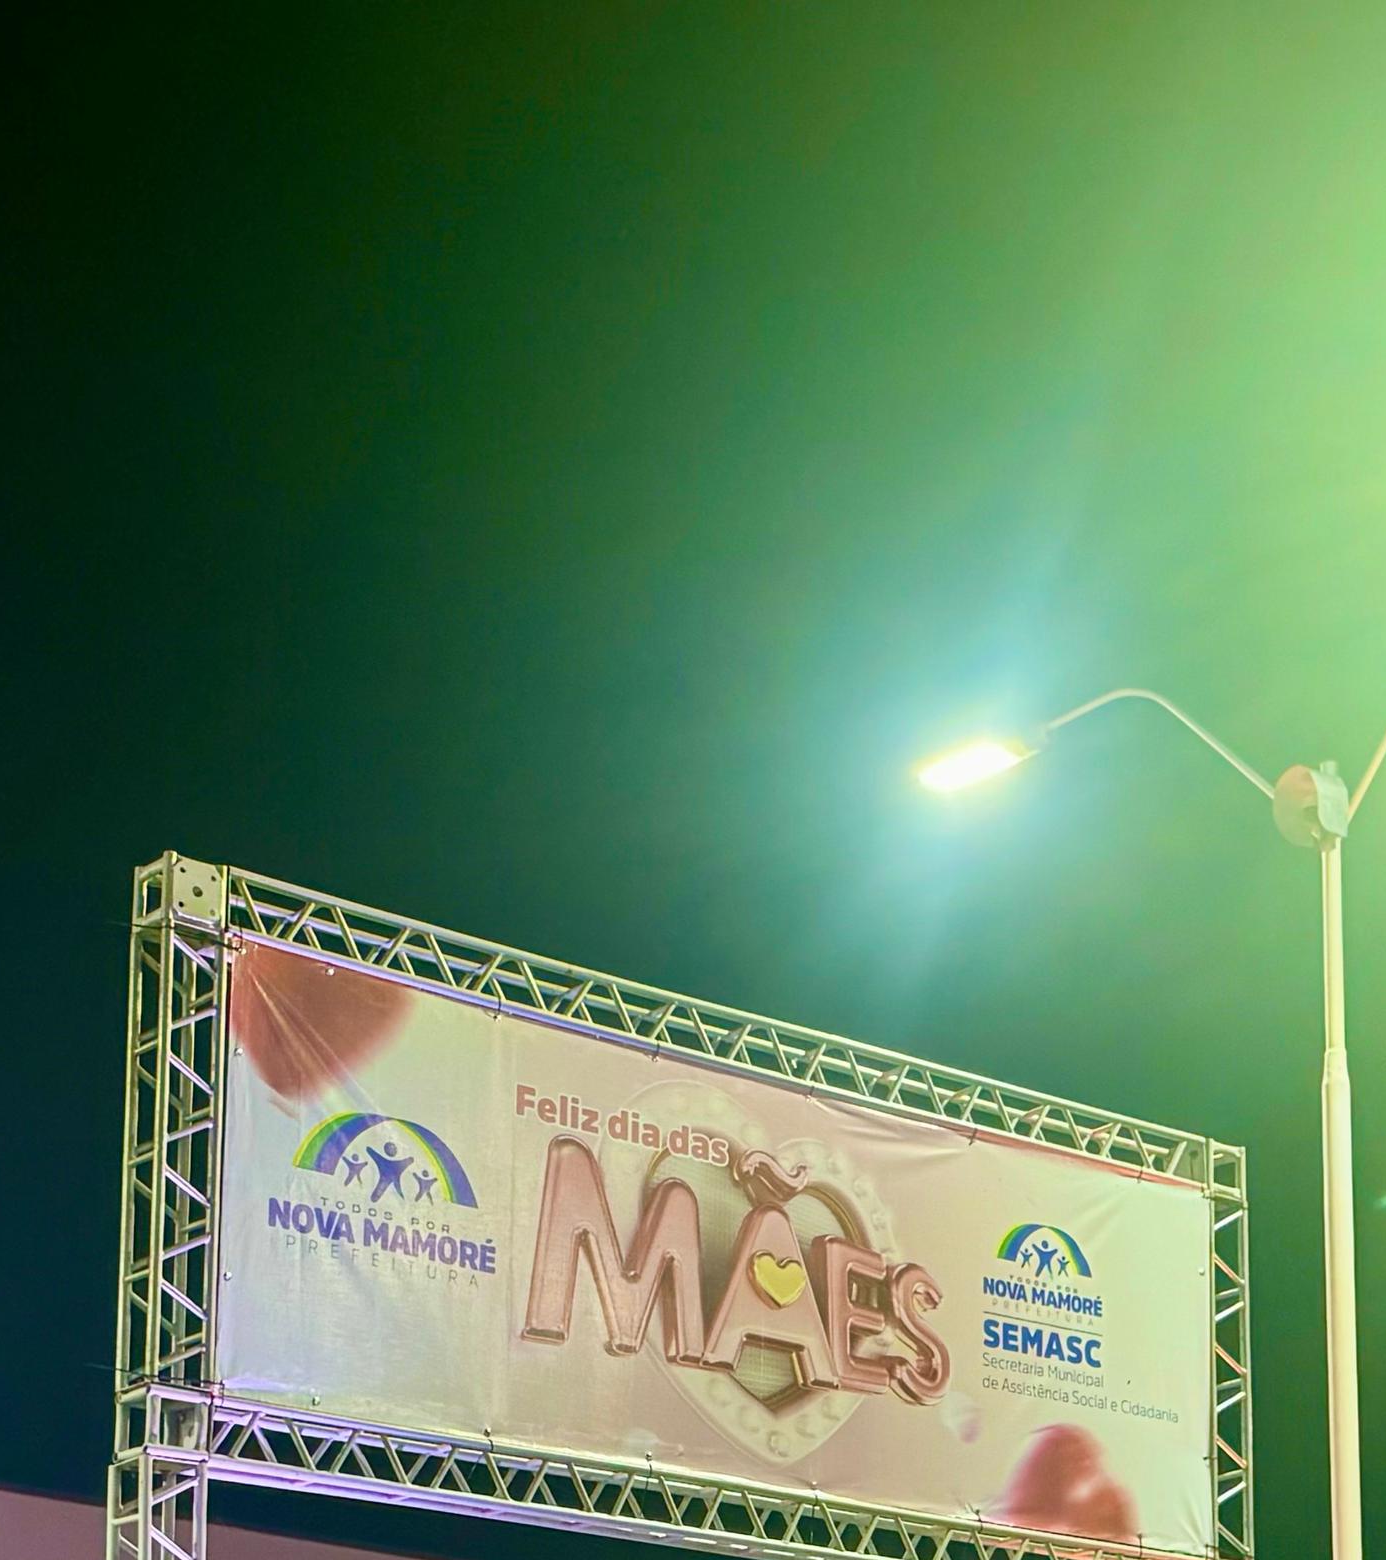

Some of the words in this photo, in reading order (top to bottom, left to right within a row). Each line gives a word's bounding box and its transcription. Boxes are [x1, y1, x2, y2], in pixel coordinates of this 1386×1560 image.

[515, 1084, 600, 1134] Feliz
[607, 1109, 661, 1149] dia
[666, 1125, 730, 1167] das
[268, 1197, 355, 1244] NOVA
[363, 1217, 496, 1274] MAMORÉ
[320, 1196, 393, 1221] TODOS
[411, 1216, 451, 1234] POR
[285, 1234, 479, 1288] PREFEITURA
[520, 1134, 951, 1407] MÃES
[983, 1276, 1027, 1303] NOVA
[1031, 1287, 1103, 1317] MAMORÉ
[983, 1318, 1102, 1369] SEMASC
[982, 1352, 1044, 1377] Secretaria
[1047, 1364, 1104, 1388] Municipal
[982, 1375, 999, 1390] de
[1001, 1377, 1069, 1403] Assistência
[1072, 1390, 1108, 1410] Social
[1110, 1400, 1118, 1412] e
[1121, 1399, 1179, 1424] Cidadania
